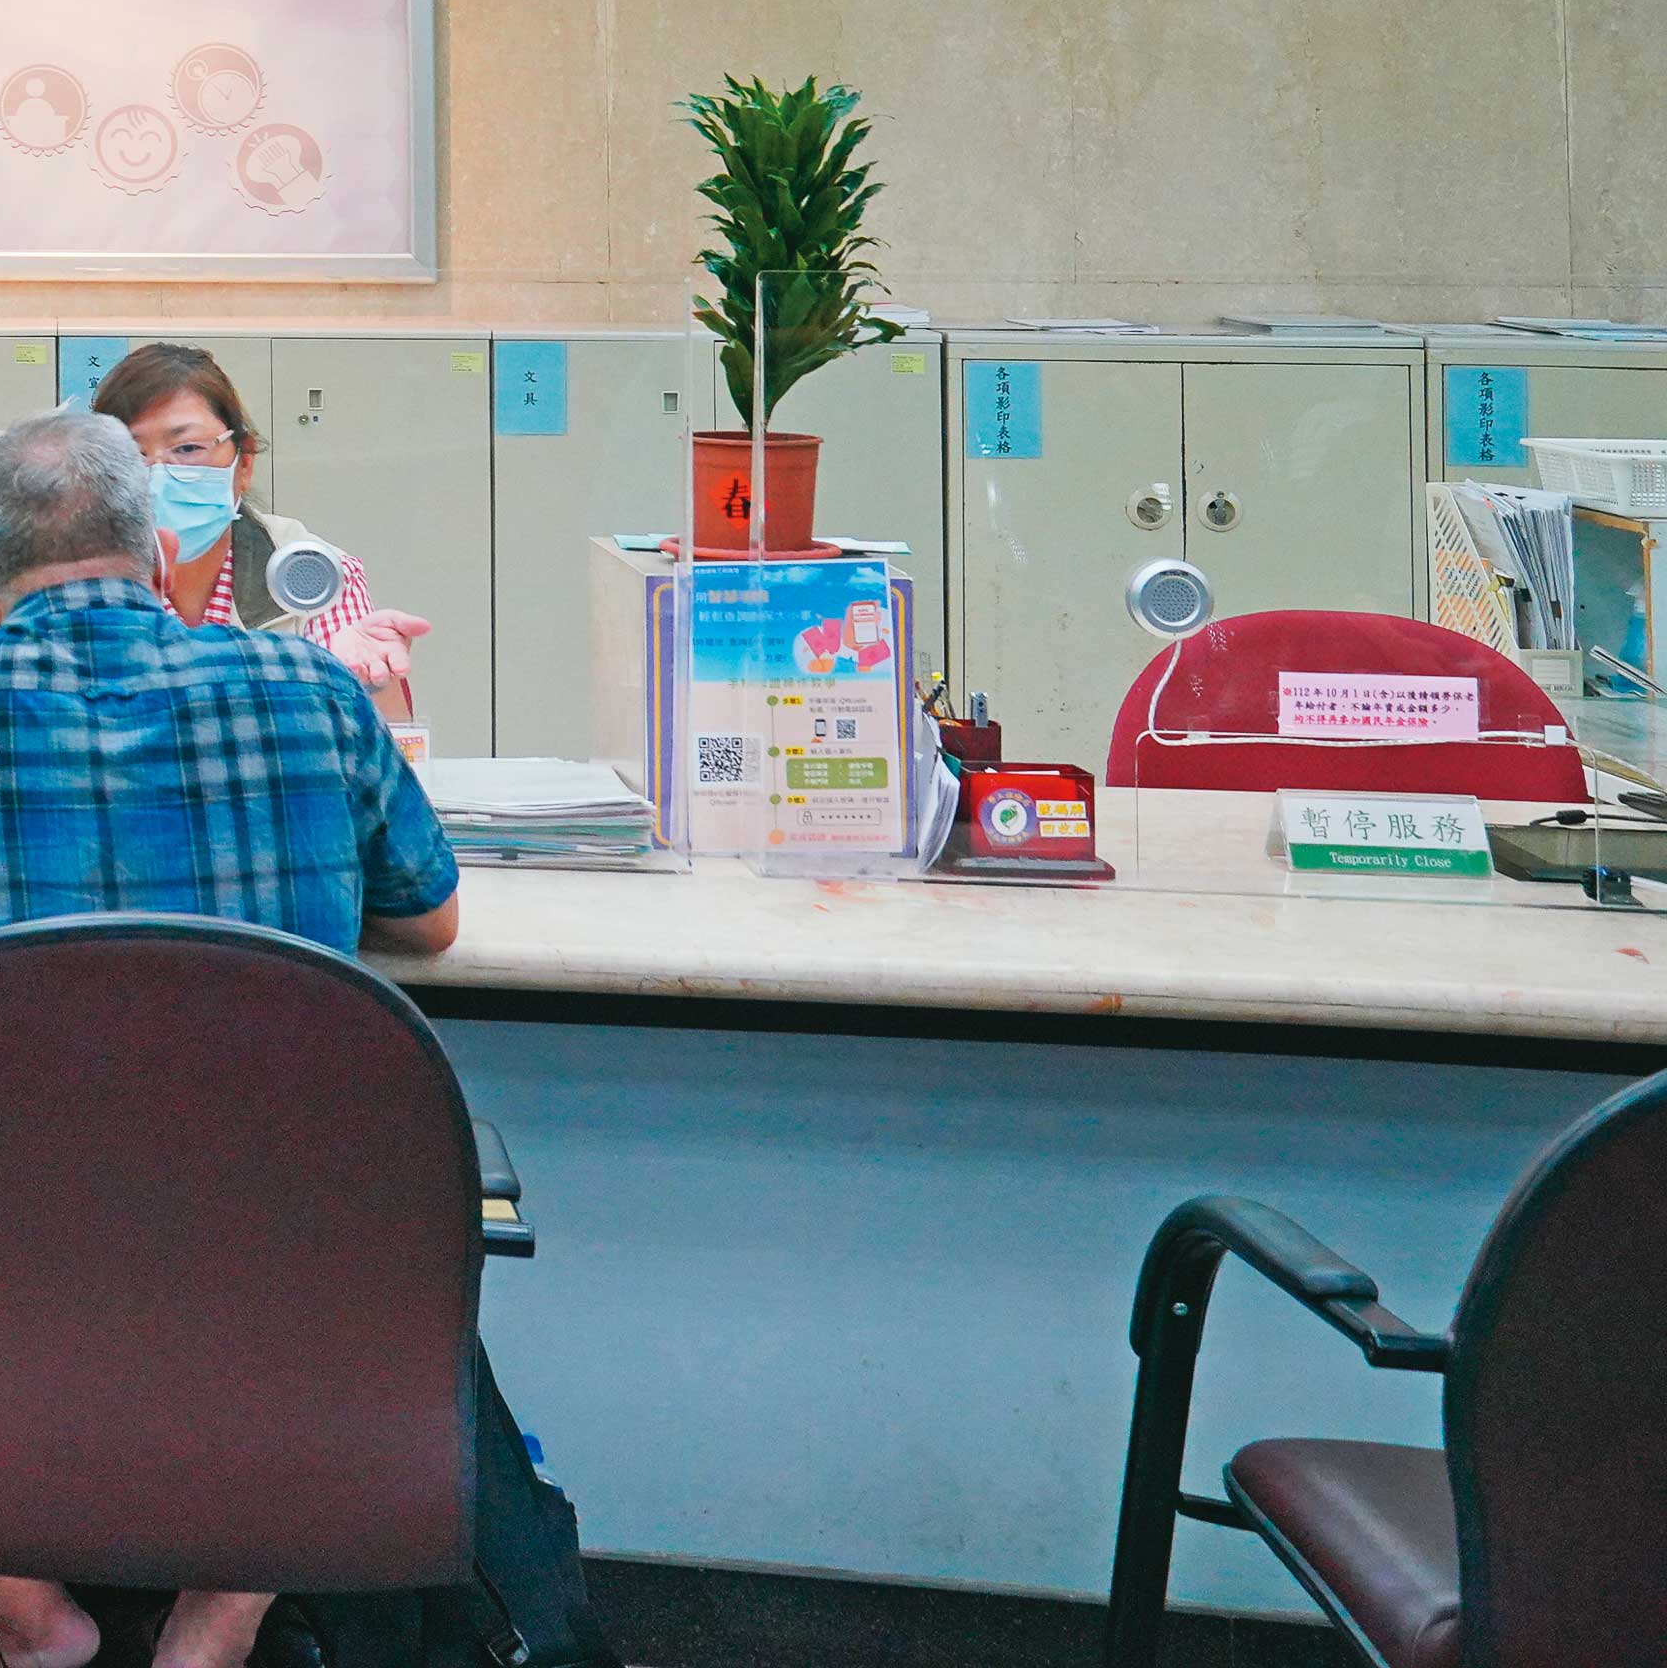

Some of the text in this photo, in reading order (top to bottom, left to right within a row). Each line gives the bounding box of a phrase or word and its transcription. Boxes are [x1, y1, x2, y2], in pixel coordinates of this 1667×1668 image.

[523, 370, 538, 406] 文具
[996, 367, 1011, 454] 各項影印表格
[1478, 371, 1496, 462] 各項影印表格
[722, 478, 751, 519] 春
[1301, 807, 1467, 844] 暫停服務
[1329, 851, 1452, 868] Temporarily Close
